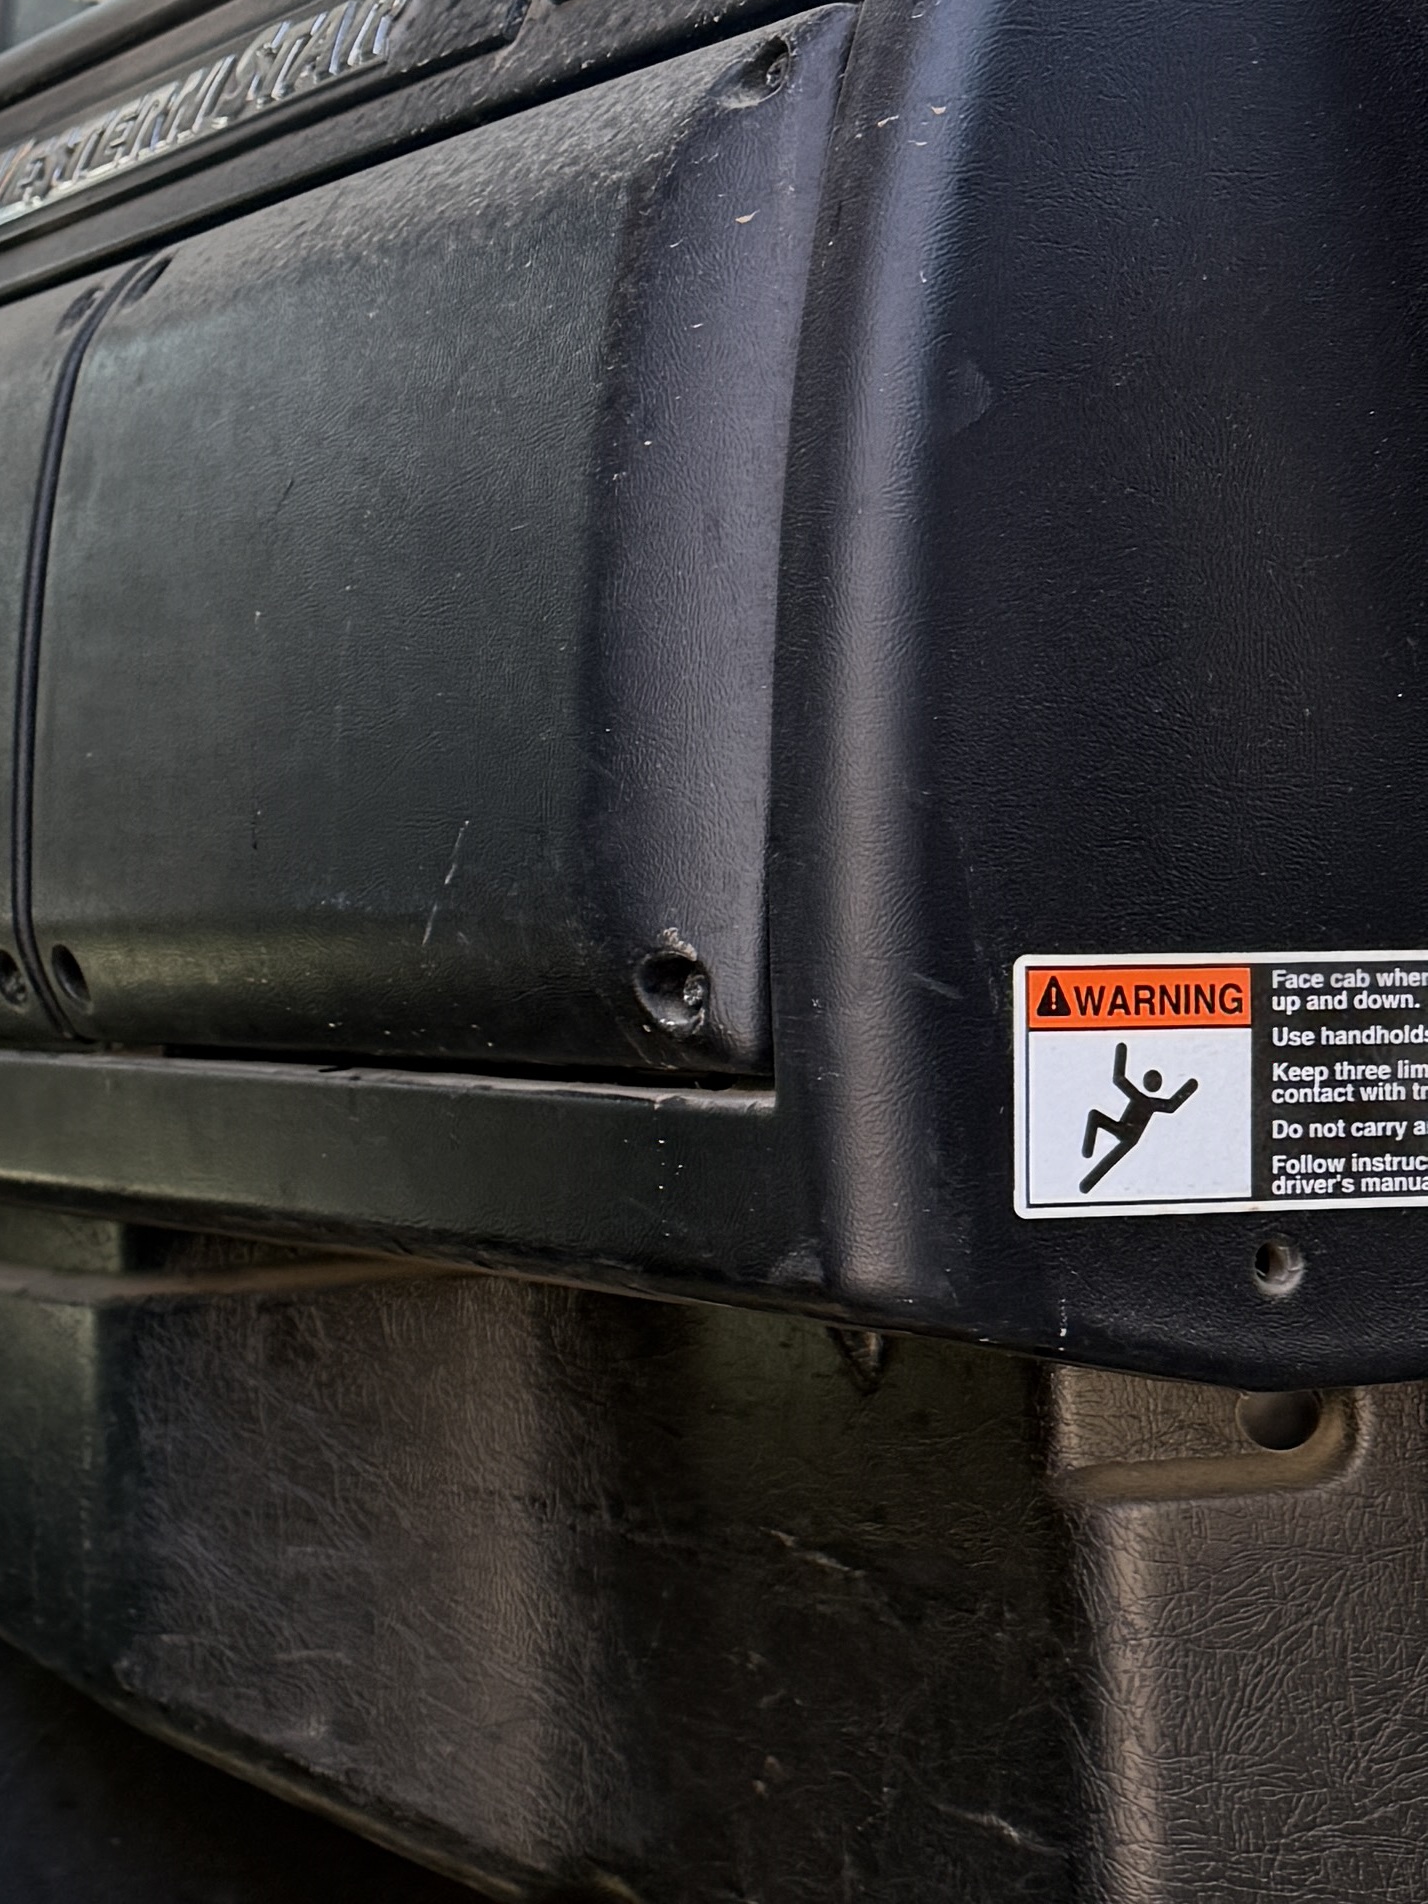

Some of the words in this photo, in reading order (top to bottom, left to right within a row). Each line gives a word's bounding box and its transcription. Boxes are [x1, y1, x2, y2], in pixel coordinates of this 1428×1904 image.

[1271, 969, 1324, 989] Face
[1330, 968, 1371, 988] cab
[1073, 982, 1244, 1018] WARNING
[1271, 995, 1301, 1015] up
[1306, 990, 1348, 1010] and
[1353, 990, 1420, 1009] down.
[1271, 1027, 1315, 1046] Use
[1271, 1062, 1329, 1089] Keep
[1334, 1060, 1391, 1080] three
[1271, 1083, 1355, 1104] contact
[1359, 1082, 1406, 1102] with
[1271, 1120, 1303, 1139] Do
[1309, 1119, 1346, 1138] not
[1350, 1120, 1408, 1141] carry
[1271, 1154, 1346, 1174] Follow
[1271, 1174, 1355, 1195] driver's
